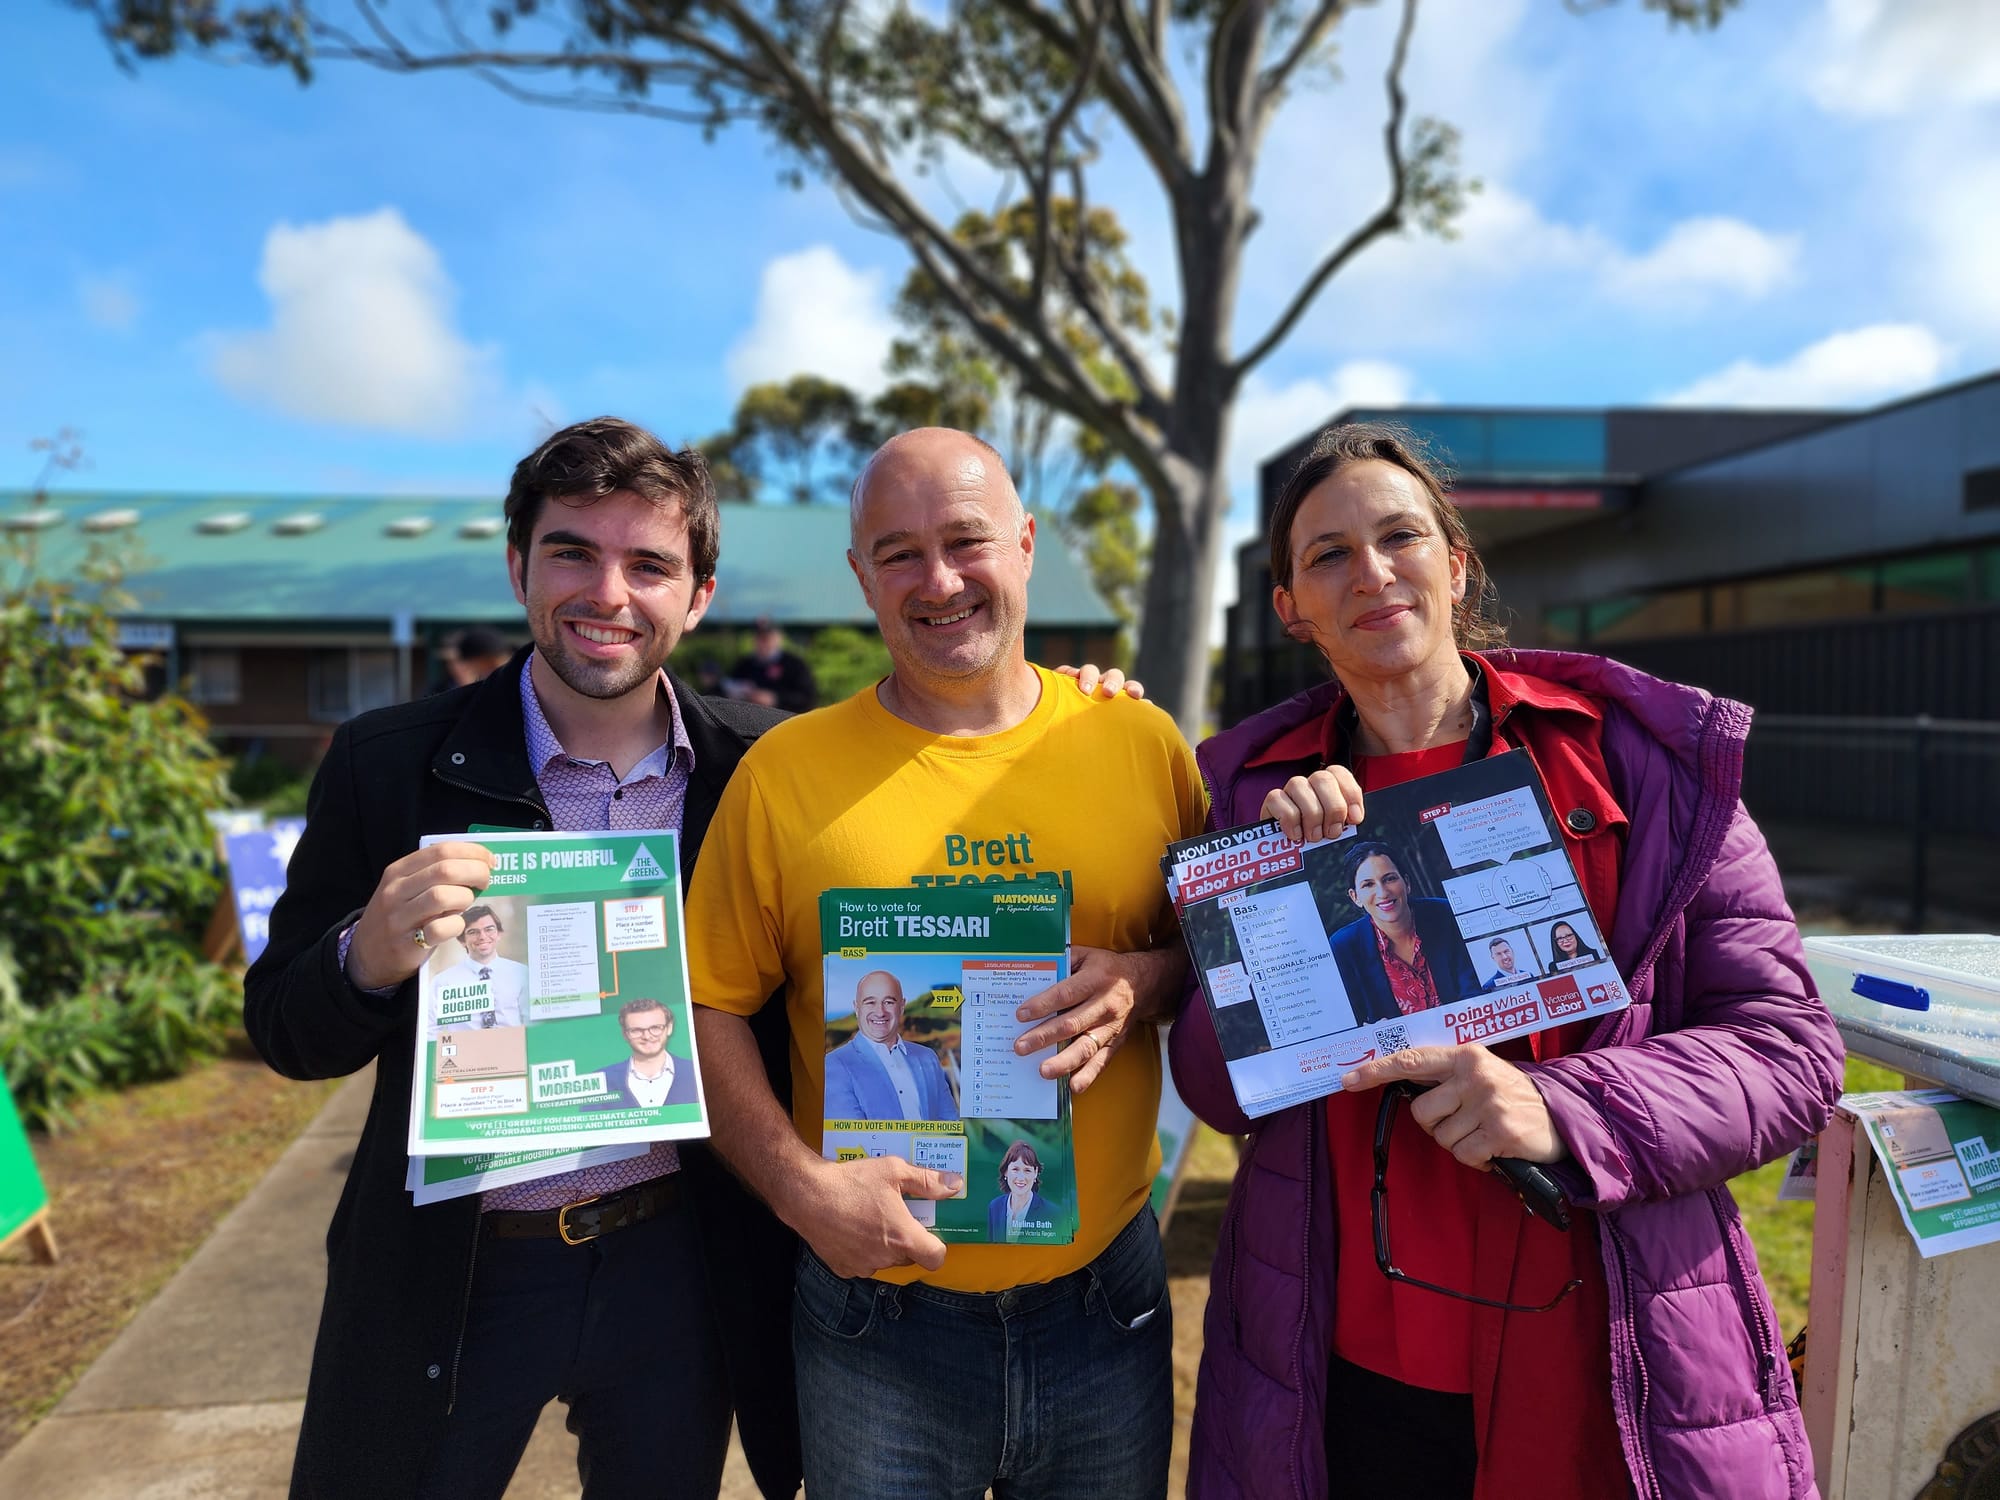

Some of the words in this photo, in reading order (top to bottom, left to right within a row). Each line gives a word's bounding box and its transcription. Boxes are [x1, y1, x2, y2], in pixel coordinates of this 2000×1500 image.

[1422, 808, 1441, 820] STEP
[1441, 806, 1448, 814] 2
[945, 832, 1034, 866] Brett
[1176, 842, 1210, 862] HOW
[1211, 837, 1232, 850] TO
[1232, 823, 1273, 845] VOTE
[493, 853, 519, 871] OTE
[523, 852, 537, 870] IS
[541, 849, 618, 869] POWERFUL
[636, 857, 651, 867] THE
[1182, 849, 1251, 882] Jordan
[628, 866, 660, 877] GREENS
[1186, 873, 1229, 900] Labor
[1232, 866, 1256, 886] for
[1259, 856, 1297, 876] Bass
[488, 874, 527, 885] GREENS
[996, 894, 1057, 904] NATIONALS
[1222, 895, 1239, 905] STEP
[624, 904, 639, 913] STEP
[839, 901, 864, 913] How
[867, 902, 878, 913] to
[881, 902, 904, 913] vote
[907, 901, 921, 913] for
[995, 904, 1005, 914] for
[1233, 904, 1258, 916] Bass
[839, 915, 889, 938] Brett
[893, 915, 990, 938] TESSARI
[842, 949, 864, 958] BASS
[1251, 960, 1260, 968] 10
[1255, 971, 1262, 981] 1
[1266, 958, 1307, 974] CRUGNALE,
[1307, 951, 1331, 963] Jordan
[442, 983, 487, 1001] CALLUM
[936, 994, 954, 1003] STEP
[1544, 991, 1581, 1006] Victorian
[442, 997, 490, 1014] BUGBIRD
[1444, 1000, 1494, 1028] Doing
[1495, 991, 1532, 1011] What
[1547, 1000, 1583, 1017] Labor
[454, 1014, 469, 1023] BASS
[1457, 1007, 1537, 1043] Matters
[442, 1035, 452, 1044] M
[1299, 1056, 1319, 1067] about
[1320, 1053, 1332, 1061] me
[538, 1065, 570, 1081] MAT
[1301, 1065, 1313, 1074] QR
[1313, 1062, 1331, 1072] code
[471, 1086, 487, 1094] STEP
[539, 1077, 601, 1098] MORGAN
[587, 1094, 620, 1103] VICTORIA
[469, 1121, 493, 1131] VOTE
[588, 1112, 626, 1121] CLIMATE
[628, 1109, 662, 1118] ACTION,
[484, 1126, 542, 1137] AFFORDABLE
[543, 1123, 583, 1133] HOUSING
[584, 1121, 603, 1130] AND
[604, 1117, 649, 1128] INTEGRITY
[834, 1121, 851, 1130] HOW
[854, 1121, 863, 1130] TO
[865, 1121, 883, 1130] VOTE
[886, 1121, 893, 1130] IN
[896, 1122, 909, 1130] THE
[911, 1122, 935, 1131] UPPER
[937, 1122, 962, 1131] HOUSE
[840, 1153, 859, 1161] STEP
[1960, 1142, 1985, 1162] MAT
[463, 1155, 481, 1165] VOTE
[474, 1156, 522, 1172] AFFORDABLE
[522, 1149, 554, 1162] HOUSING
[1969, 1156, 2000, 1181] MORG
[1012, 1220, 1035, 1228] Melina
[1036, 1220, 1052, 1229] Bath
